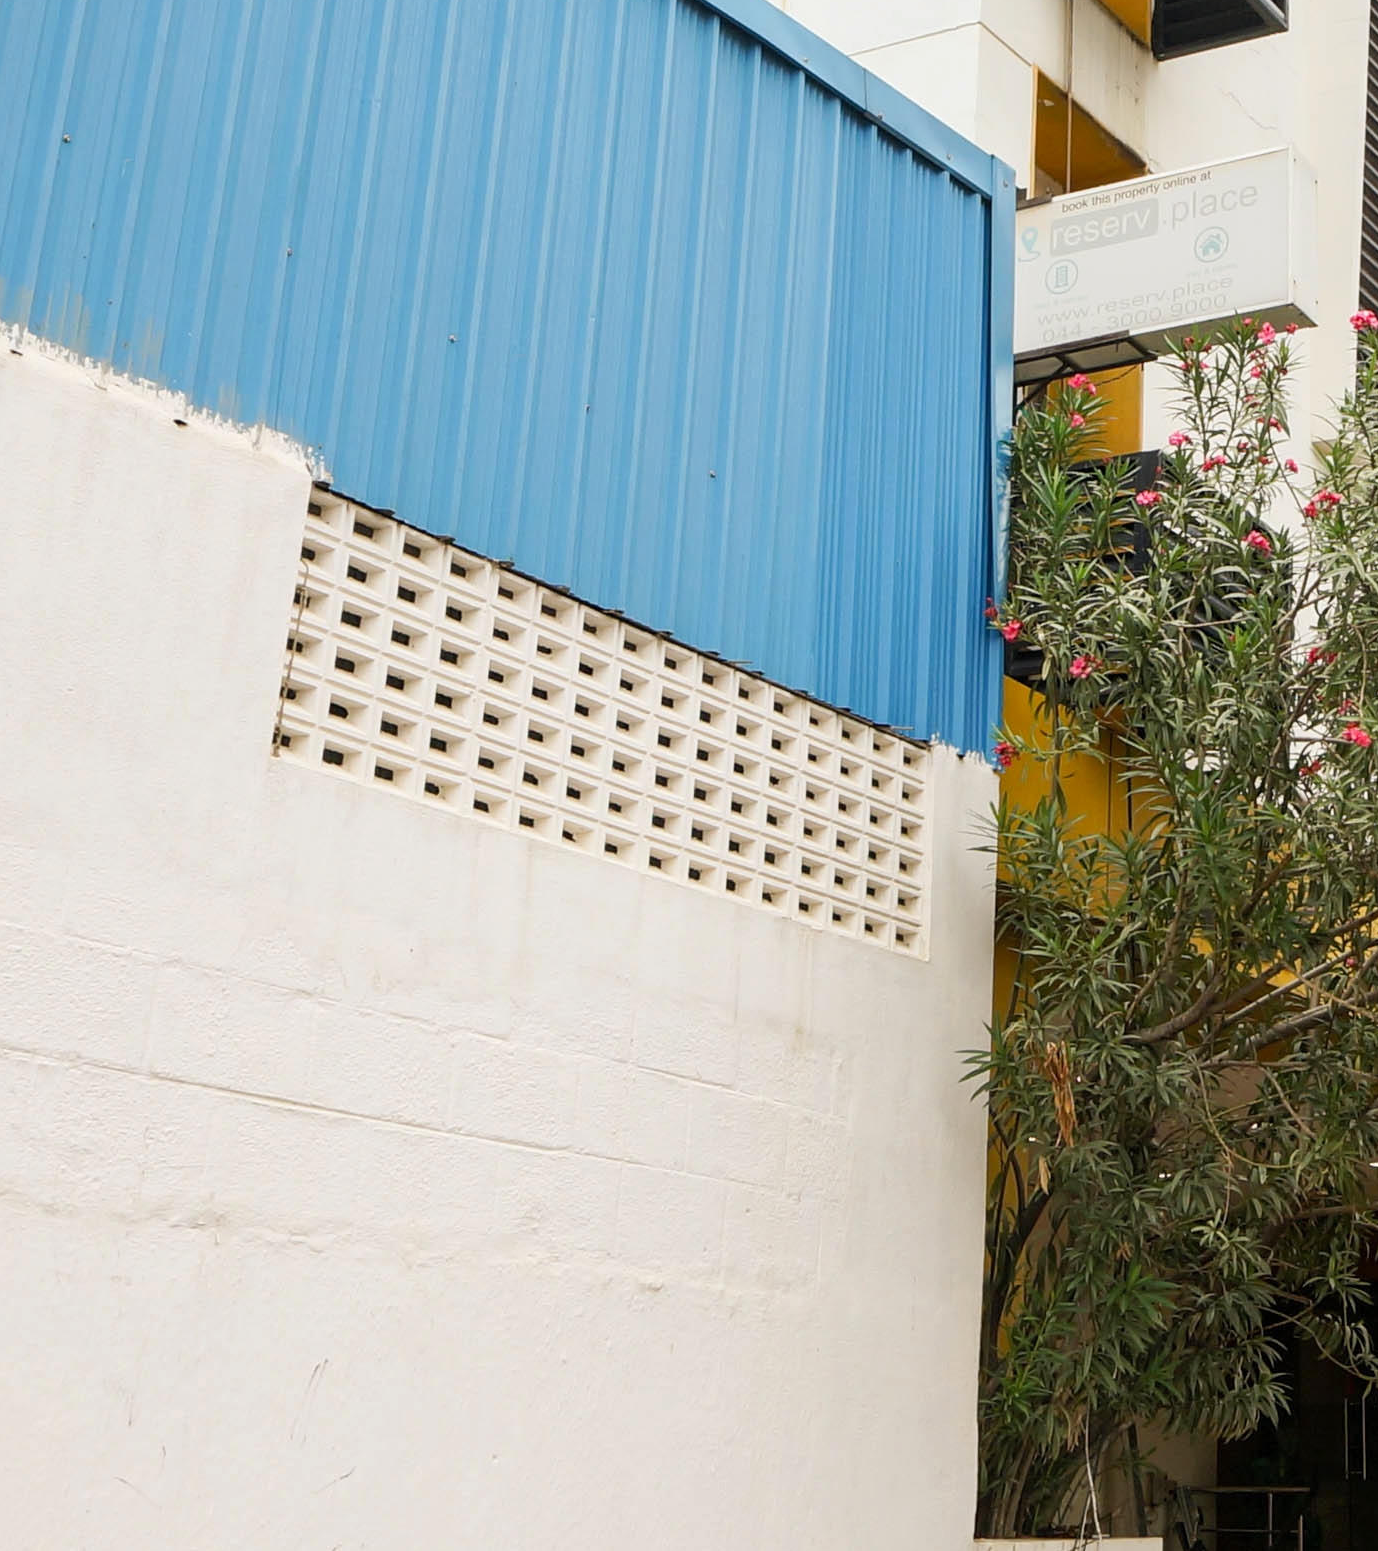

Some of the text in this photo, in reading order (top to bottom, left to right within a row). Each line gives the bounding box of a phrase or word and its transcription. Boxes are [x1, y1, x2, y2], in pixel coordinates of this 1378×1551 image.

[1061, 169, 1212, 214] book this property online at
[1037, 274, 1234, 327] www.reserv.place
[1107, 307, 1162, 332] 3000
